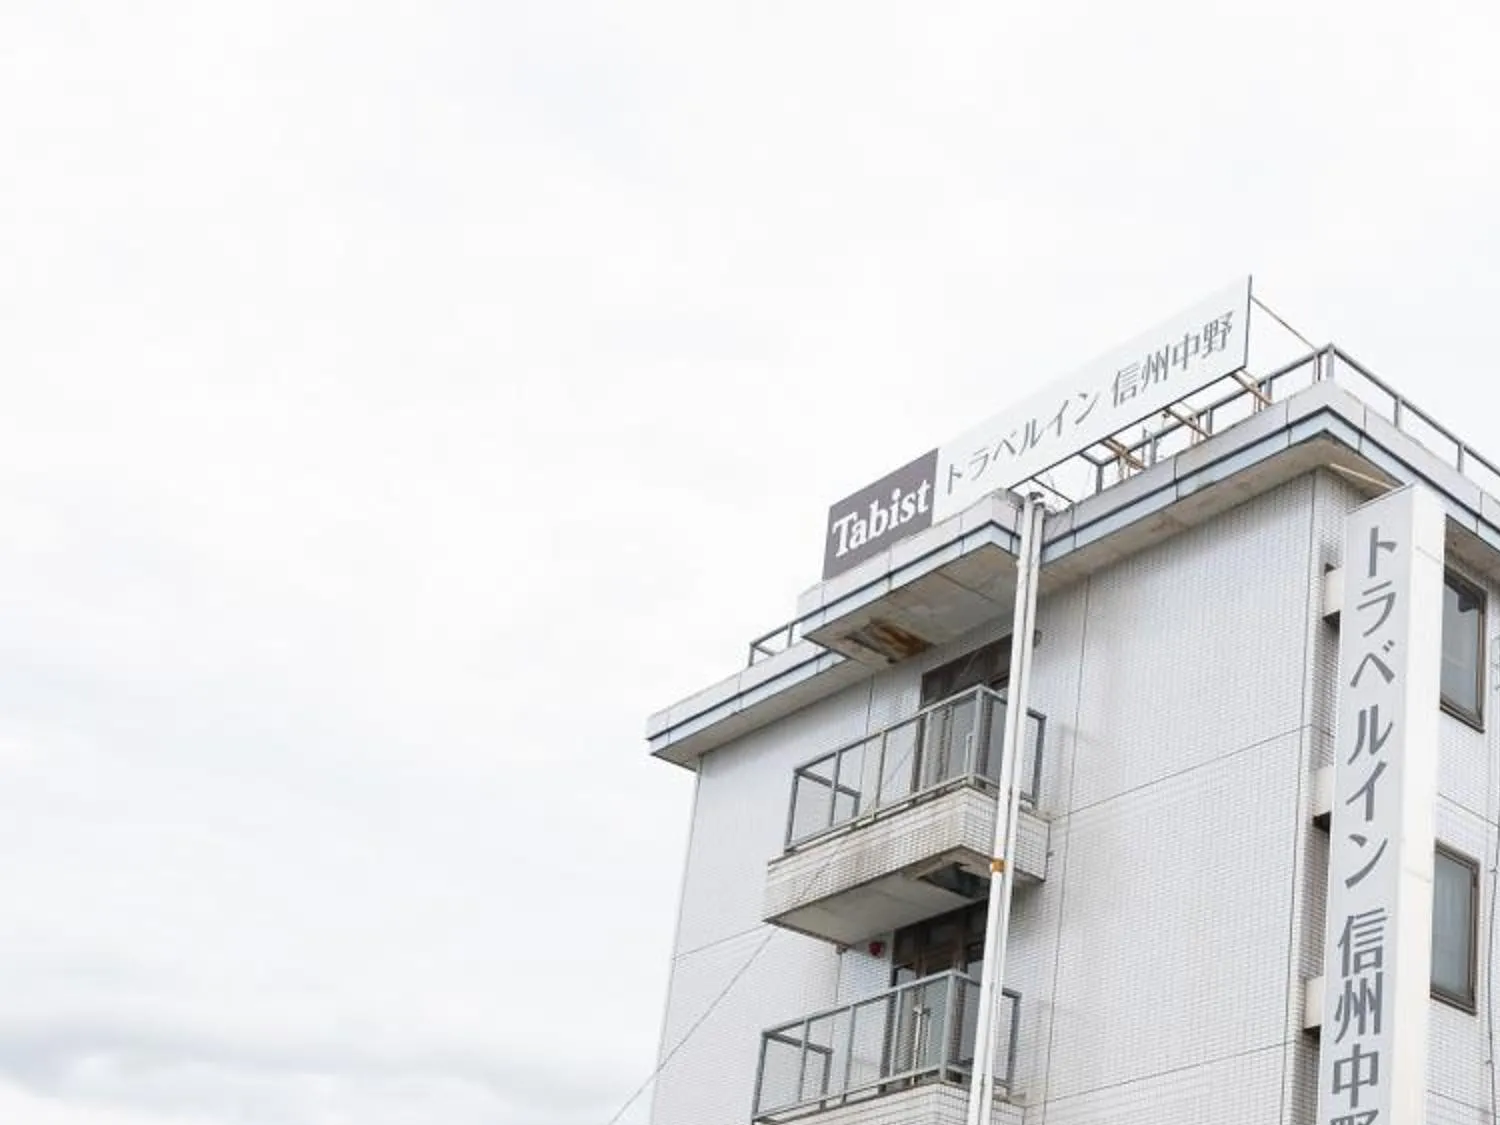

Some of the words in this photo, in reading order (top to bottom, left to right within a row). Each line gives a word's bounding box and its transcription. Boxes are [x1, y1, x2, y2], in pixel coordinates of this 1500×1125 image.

[946, 391, 1099, 494] トラベルイン
[1112, 310, 1234, 408] 信州中野
[832, 480, 929, 558] Tabist
[1345, 525, 1398, 889] トラベルイン
